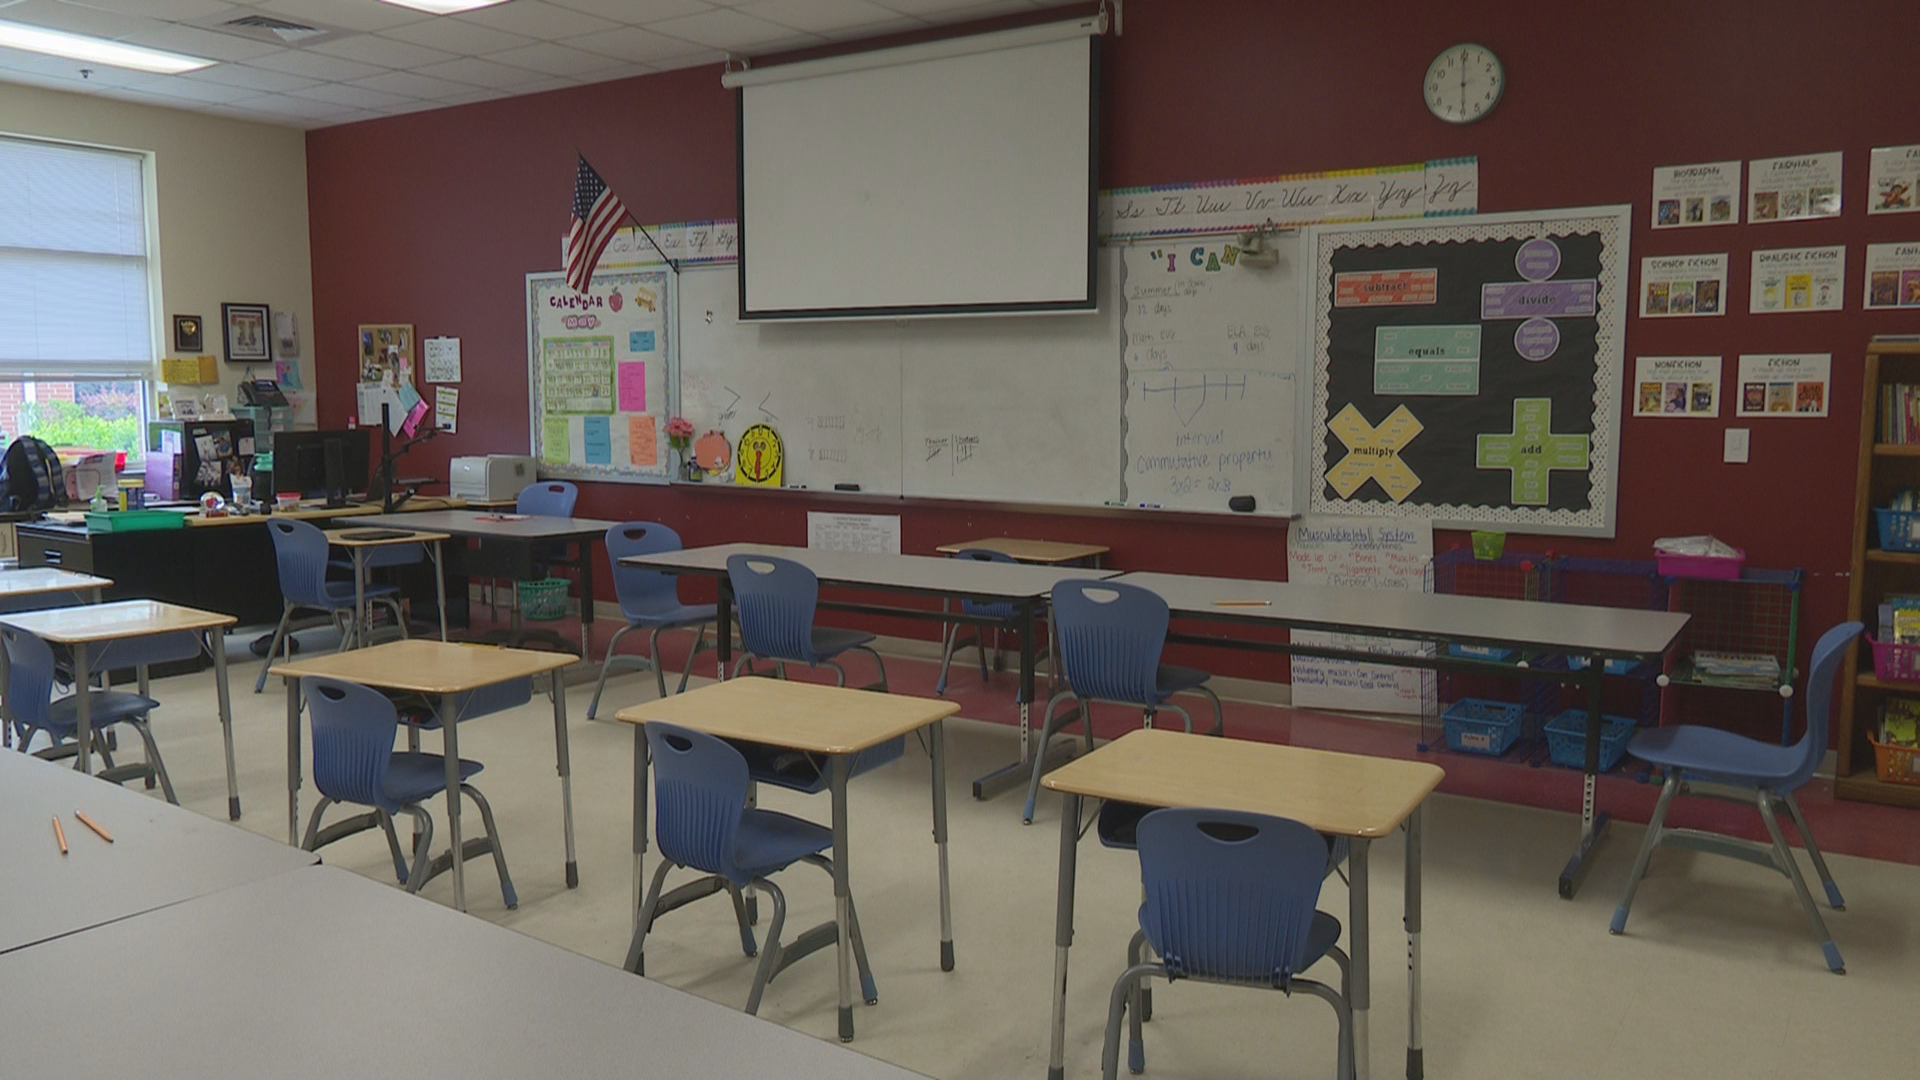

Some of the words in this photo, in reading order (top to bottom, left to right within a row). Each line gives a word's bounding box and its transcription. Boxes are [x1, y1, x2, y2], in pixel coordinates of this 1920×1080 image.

[1447, 57, 1454, 67] 11
[1477, 54, 1480, 64] 1
[1437, 69, 1446, 79] 10
[1485, 63, 1492, 73] 2
[1489, 76, 1496, 86] 3
[1432, 83, 1438, 93] 9
[1436, 96, 1442, 106] 8
[1484, 91, 1491, 101] 4
[1447, 105, 1453, 114] 7
[1474, 102, 1480, 112] 5
[1190, 244, 1241, 273] CAN
[1134, 285, 1172, 297] Summer
[1363, 281, 1407, 293] subtract
[550, 293, 604, 312] CALENDAR
[1518, 294, 1556, 306] divide
[1154, 301, 1172, 318] days
[566, 314, 597, 329] May
[1226, 324, 1247, 341] ELA
[1246, 341, 1266, 355] days
[1408, 346, 1446, 359] equals
[1146, 346, 1169, 367] days
[1768, 358, 1800, 368] FICTION
[1176, 429, 1224, 447] interval
[1353, 446, 1395, 459] multiply
[1520, 444, 1543, 455] add
[1218, 448, 1274, 473] property
[1379, 526, 1416, 544] System
[1289, 551, 1311, 562] Made
[1315, 554, 1324, 563] up
